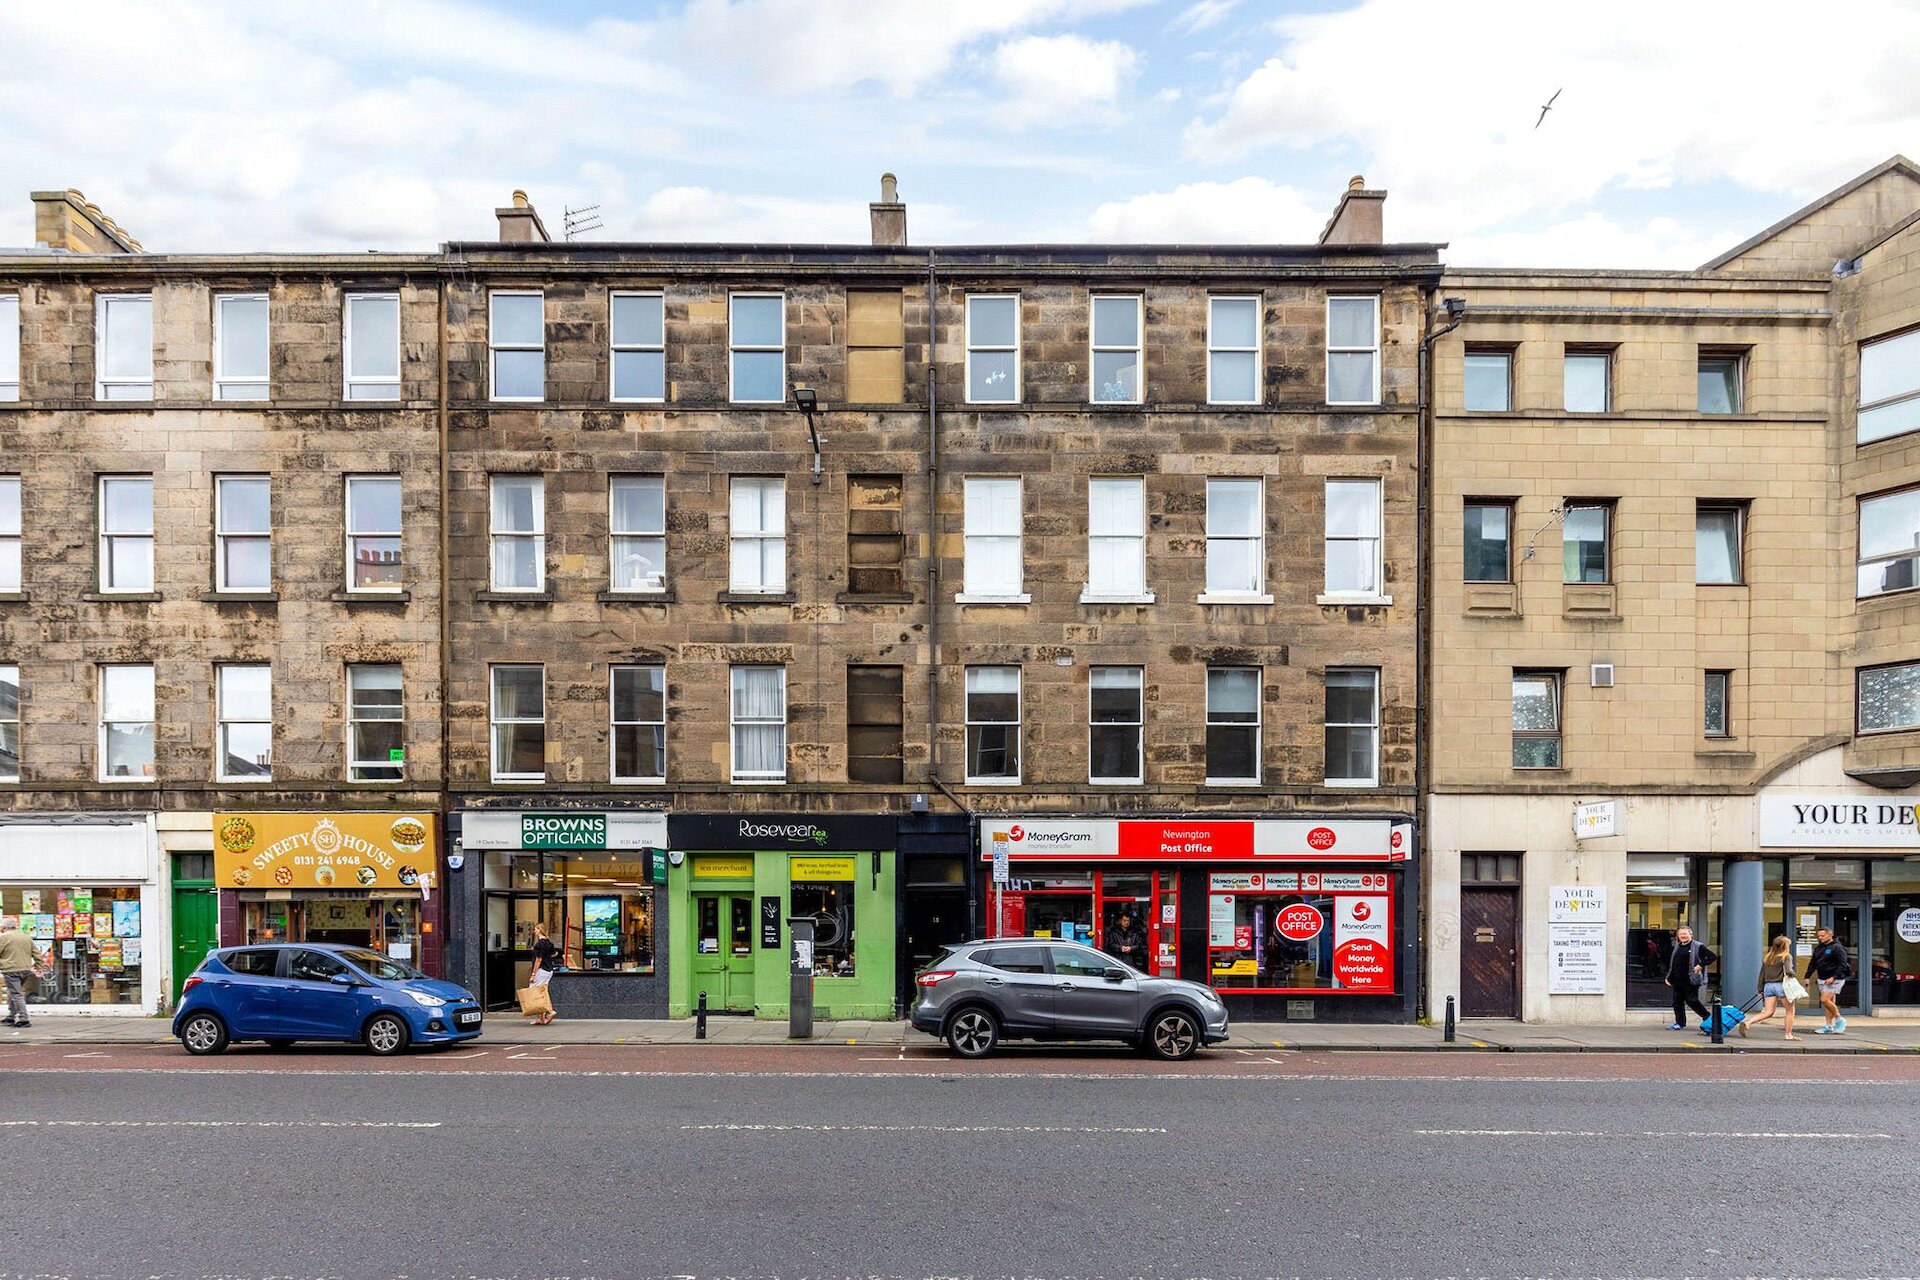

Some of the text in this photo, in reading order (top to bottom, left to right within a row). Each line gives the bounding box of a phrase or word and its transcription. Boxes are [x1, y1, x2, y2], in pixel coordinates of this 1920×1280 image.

[1585, 805, 1605, 814] YOUR
[1793, 804, 1920, 826] YOUR DE
[523, 818, 604, 831] BROWNS
[739, 819, 817, 837] Rosevear
[811, 828, 826, 837] tea
[1163, 830, 1210, 840] Newington
[1313, 831, 1331, 839] POST
[318, 833, 334, 844] SH
[523, 832, 604, 845] OPTICIANS
[1027, 832, 1091, 843] MoneyGram
[1310, 838, 1333, 846] OFFICE
[253, 832, 396, 871] SWEETY HOUSE
[1161, 843, 1212, 852] Post Office
[294, 856, 361, 865] 0131 241 6948
[712, 863, 747, 871] merchant
[1212, 877, 1249, 885] MoneyGram
[1323, 877, 1360, 885] MoneyGram
[1564, 889, 1593, 898] YOUR
[1287, 912, 1313, 921] POST
[1281, 921, 1317, 931] OFFICE
[1348, 954, 1375, 963] Money
[1340, 965, 1384, 973] Worldwide
[1351, 976, 1372, 984] Here
